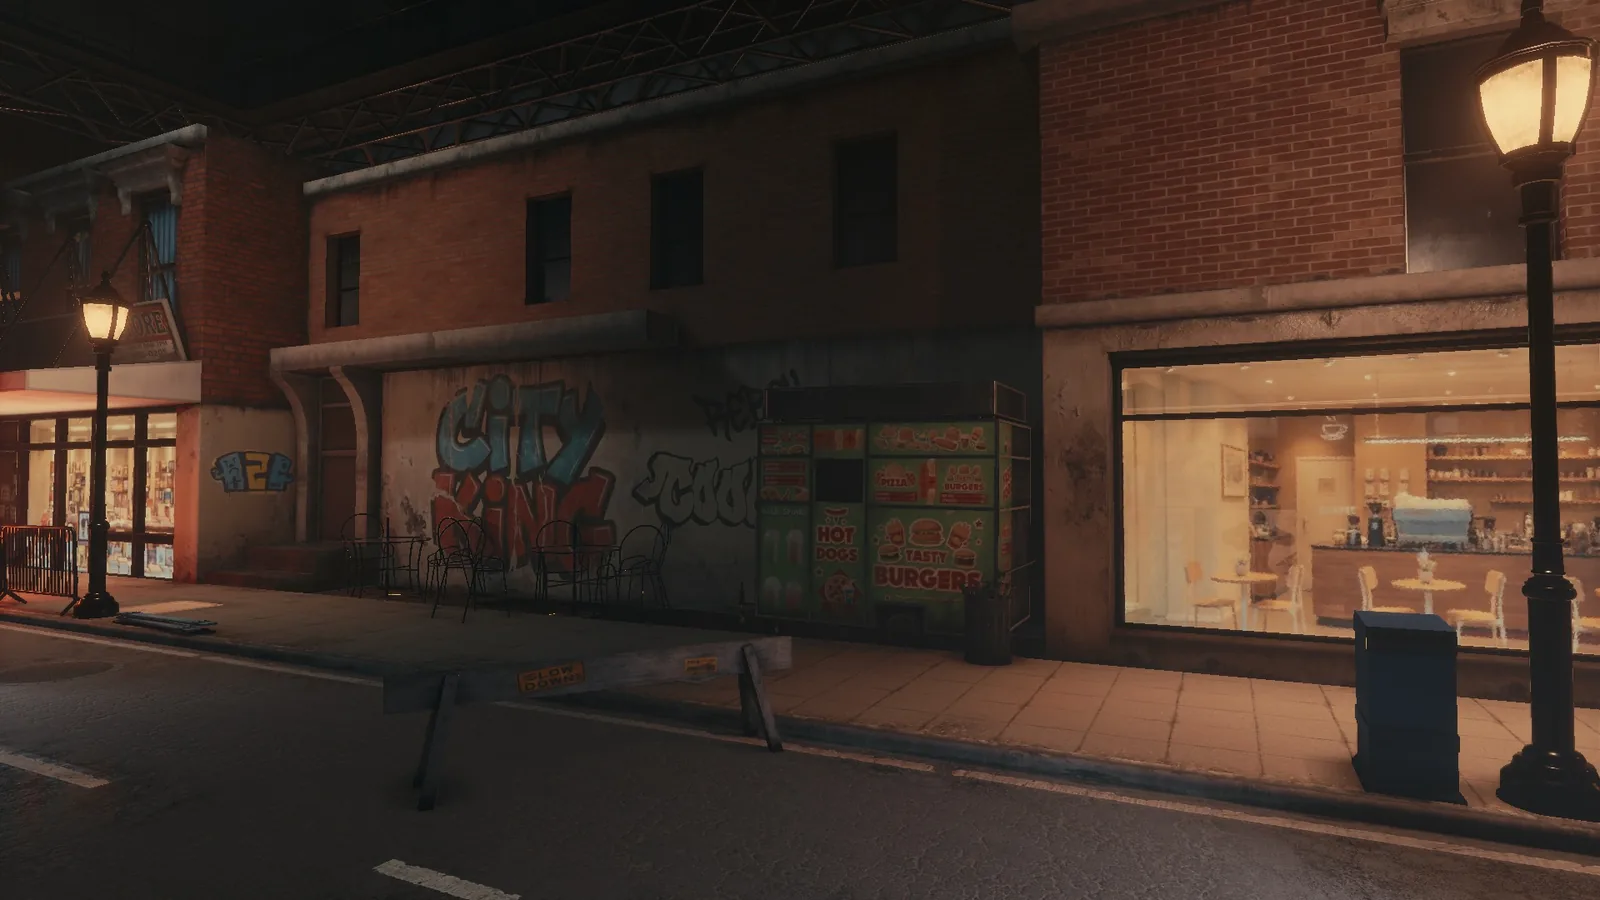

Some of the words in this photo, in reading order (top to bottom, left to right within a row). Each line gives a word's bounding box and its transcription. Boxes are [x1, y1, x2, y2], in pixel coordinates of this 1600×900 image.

[131, 310, 169, 337] ORE
[881, 478, 908, 487] PIZZA
[816, 526, 855, 543] HOT
[816, 547, 858, 561] DOGS
[905, 549, 947, 564] TASTY
[874, 565, 982, 592] BURGERS
[523, 665, 573, 682] SLOW
